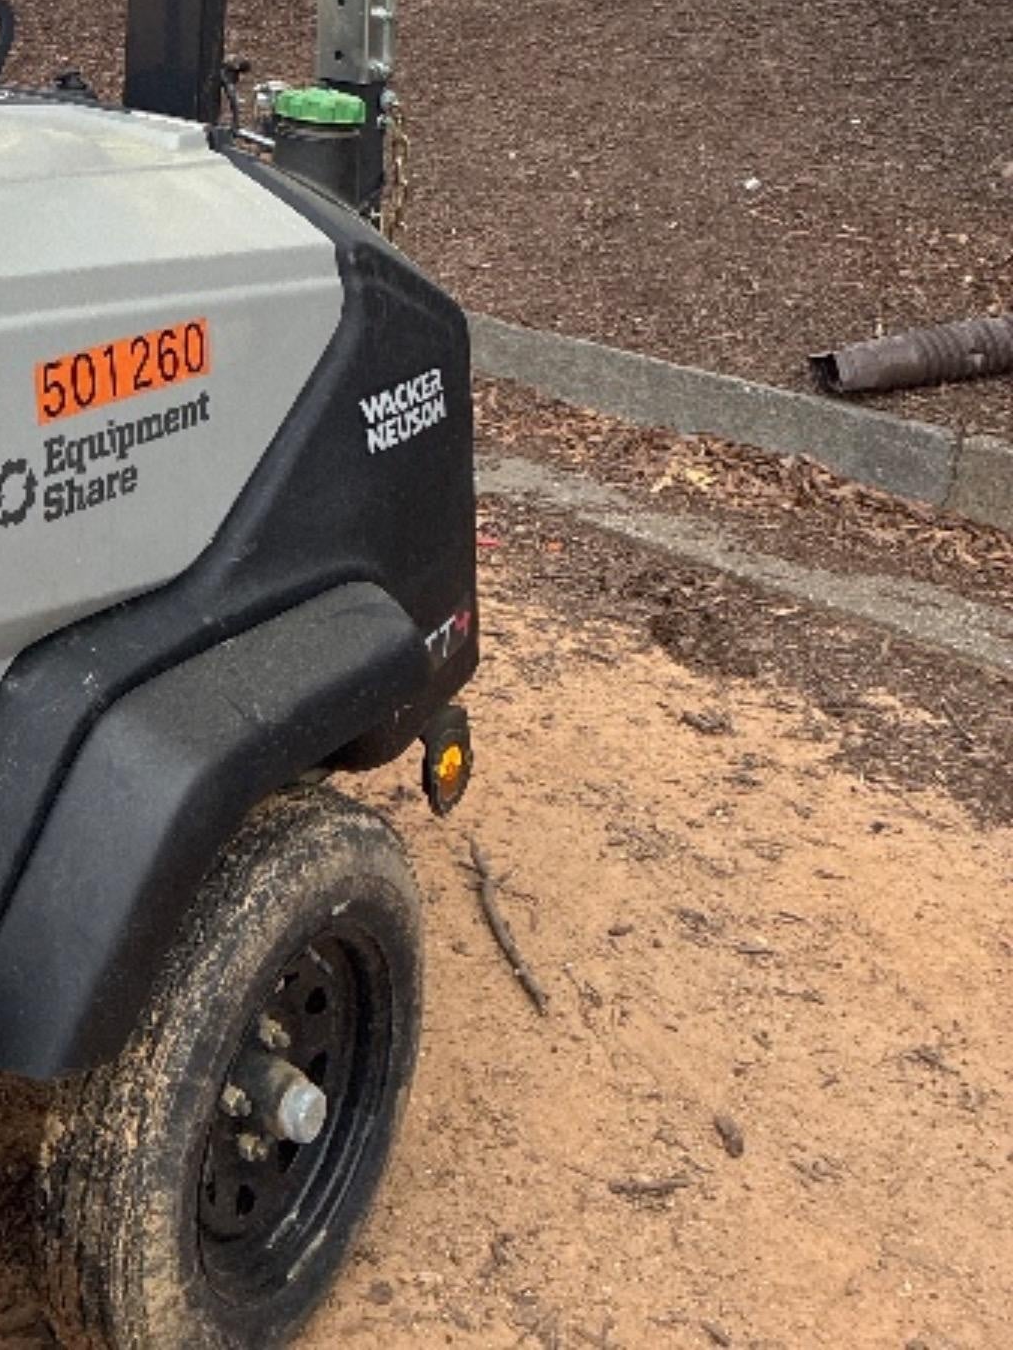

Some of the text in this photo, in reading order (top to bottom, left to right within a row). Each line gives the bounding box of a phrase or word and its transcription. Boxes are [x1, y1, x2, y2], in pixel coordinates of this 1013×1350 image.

[43, 322, 205, 418] 501260
[358, 368, 444, 424] WACKER
[43, 390, 210, 477] Equipment
[366, 392, 447, 454] NEUSON
[43, 464, 138, 522] Share
